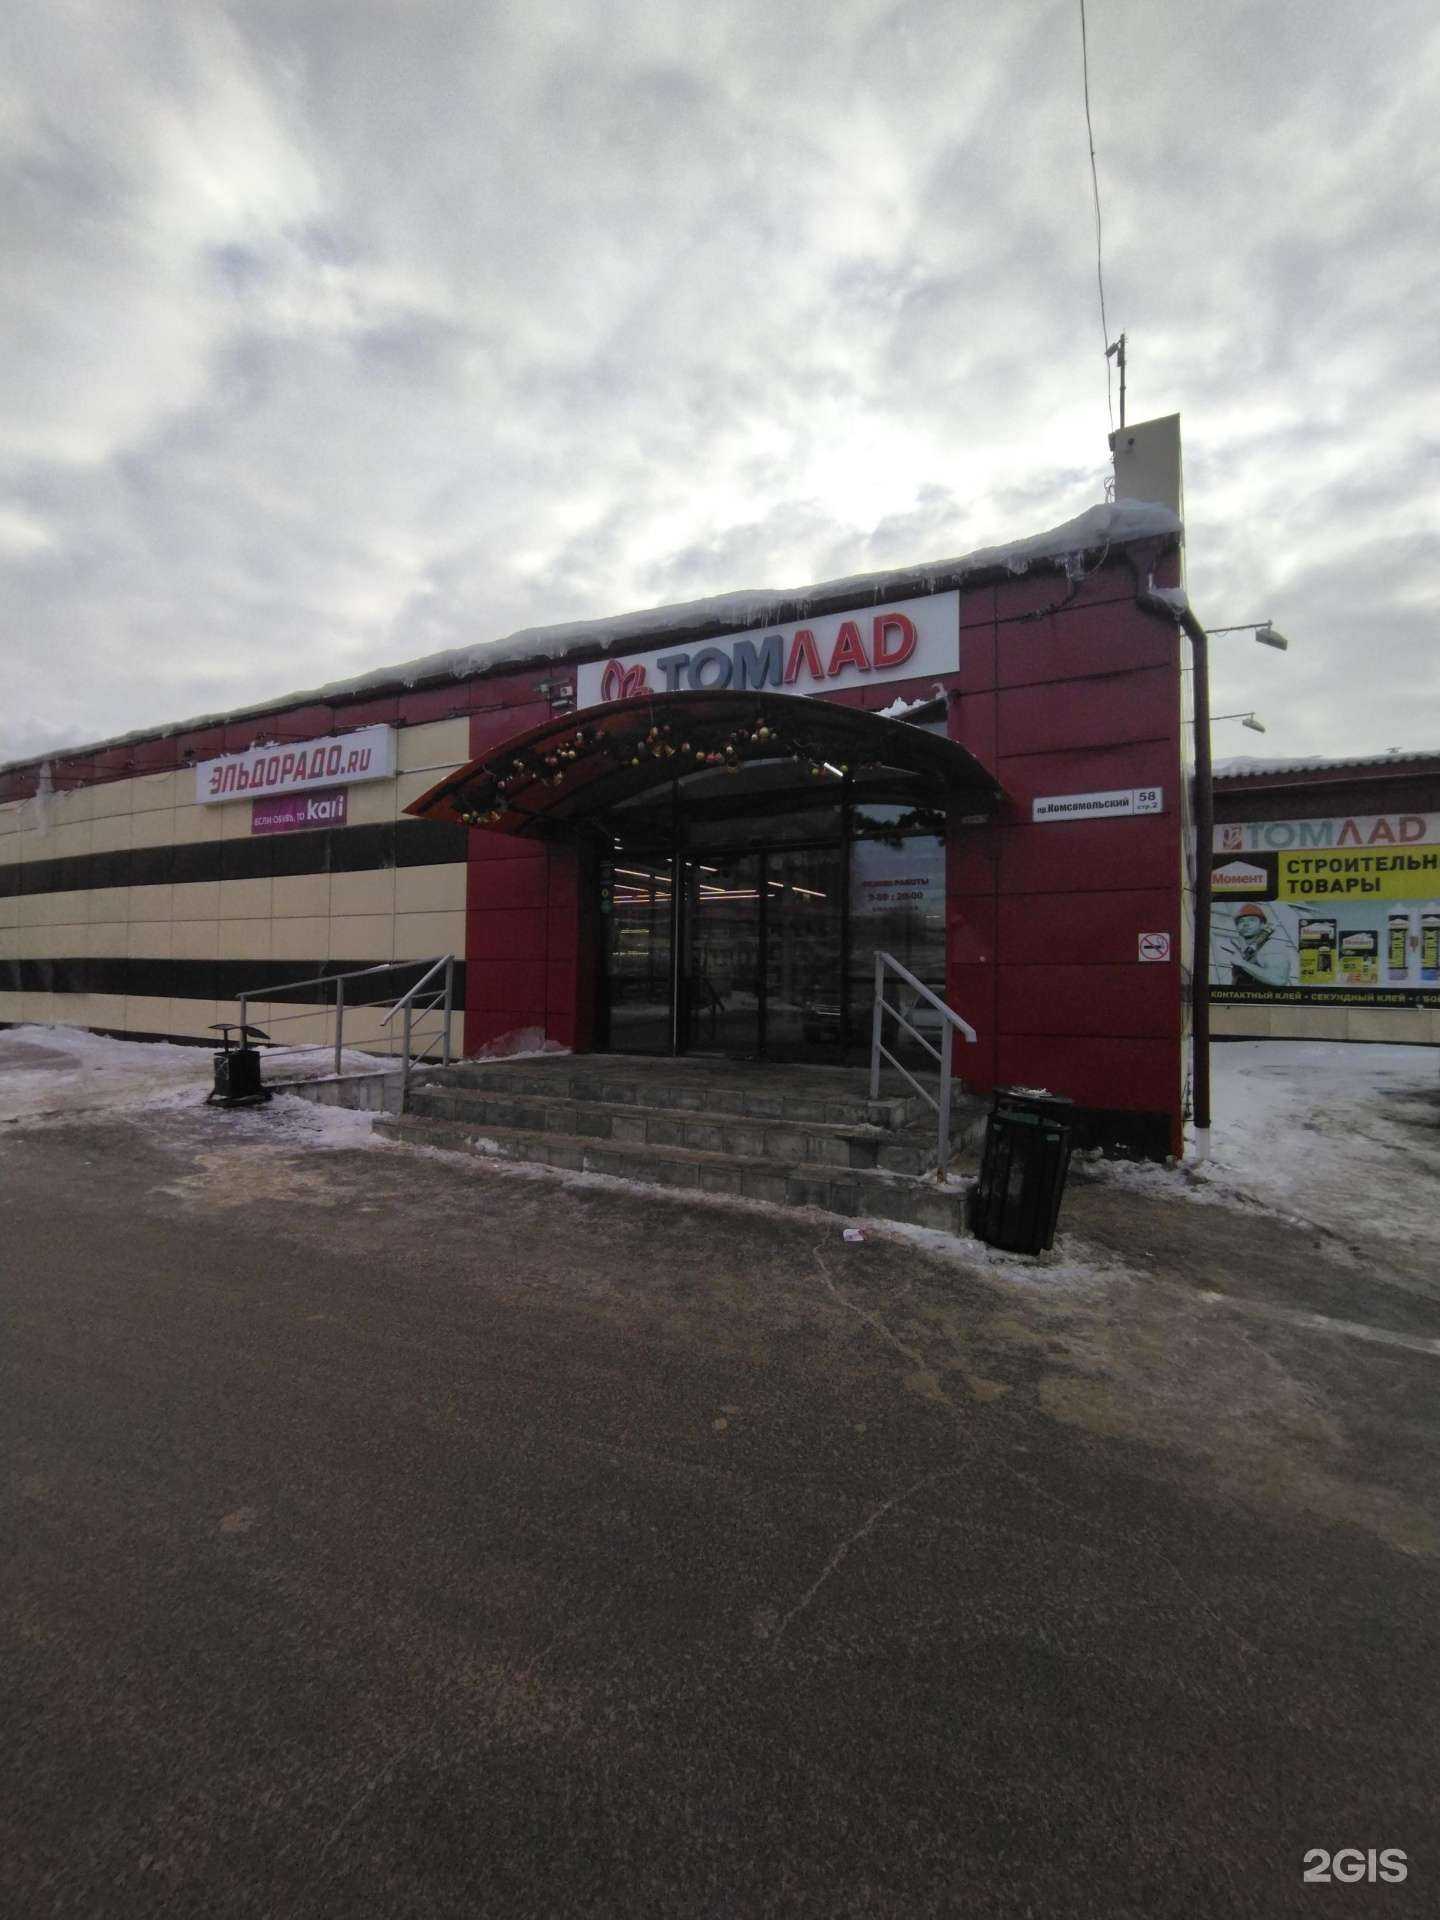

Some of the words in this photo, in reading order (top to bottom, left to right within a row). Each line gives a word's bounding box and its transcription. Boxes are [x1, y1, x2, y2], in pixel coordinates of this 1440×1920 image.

[208, 745, 371, 795] ЭЛЬДОРАДО.RU
[1139, 792, 1156, 801] 58
[307, 795, 344, 820] kari
[1211, 873, 1263, 885] Момент
[1287, 877, 1381, 894] ТОВАРЫ
[1211, 991, 1273, 1000] КОНТАКТНЫЙ
[1275, 991, 1301, 1001] КЛЕЙ
